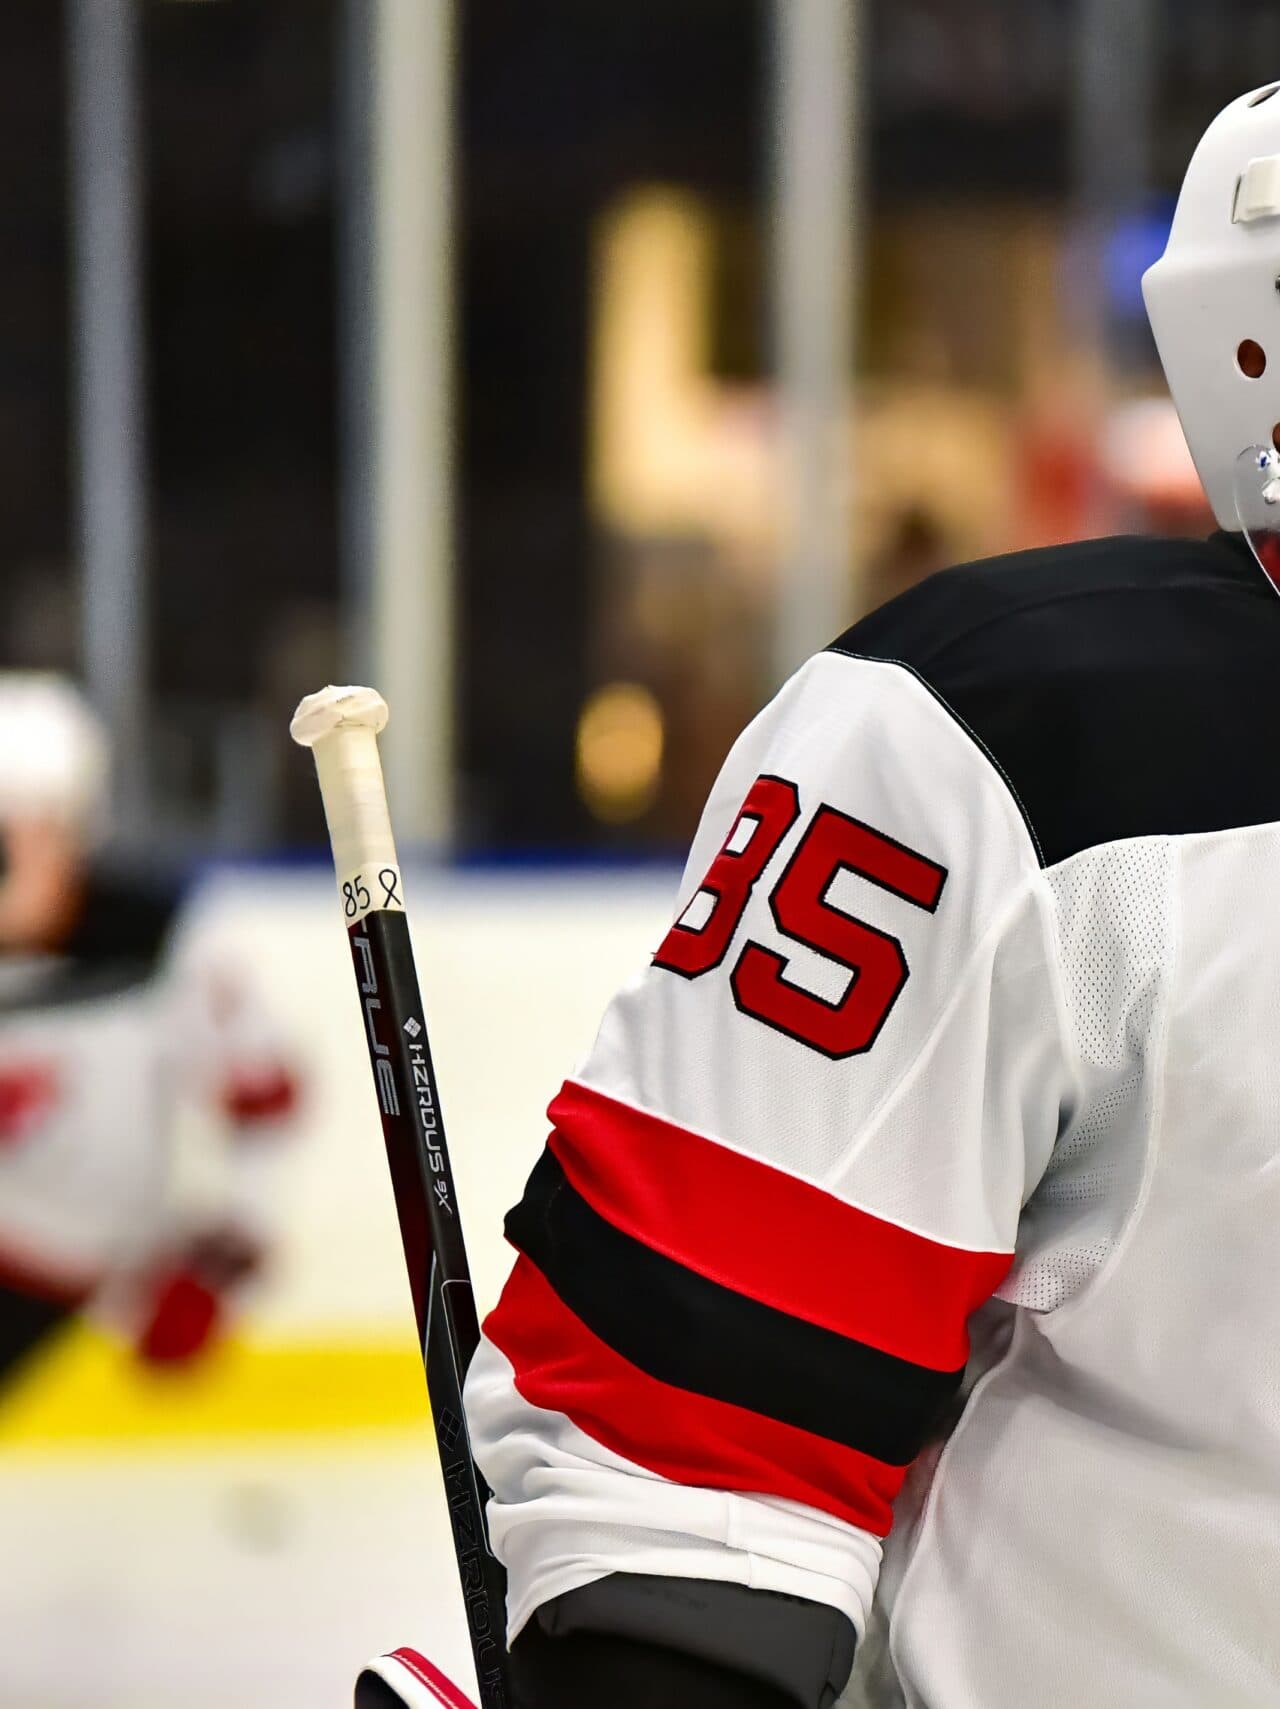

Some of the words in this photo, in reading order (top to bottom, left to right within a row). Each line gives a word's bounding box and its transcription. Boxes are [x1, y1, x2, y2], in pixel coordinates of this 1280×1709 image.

[343, 875, 370, 917] 85
[651, 774, 949, 1061] 85
[353, 919, 400, 1114] RUE
[408, 1043, 445, 1173] HZRDUS
